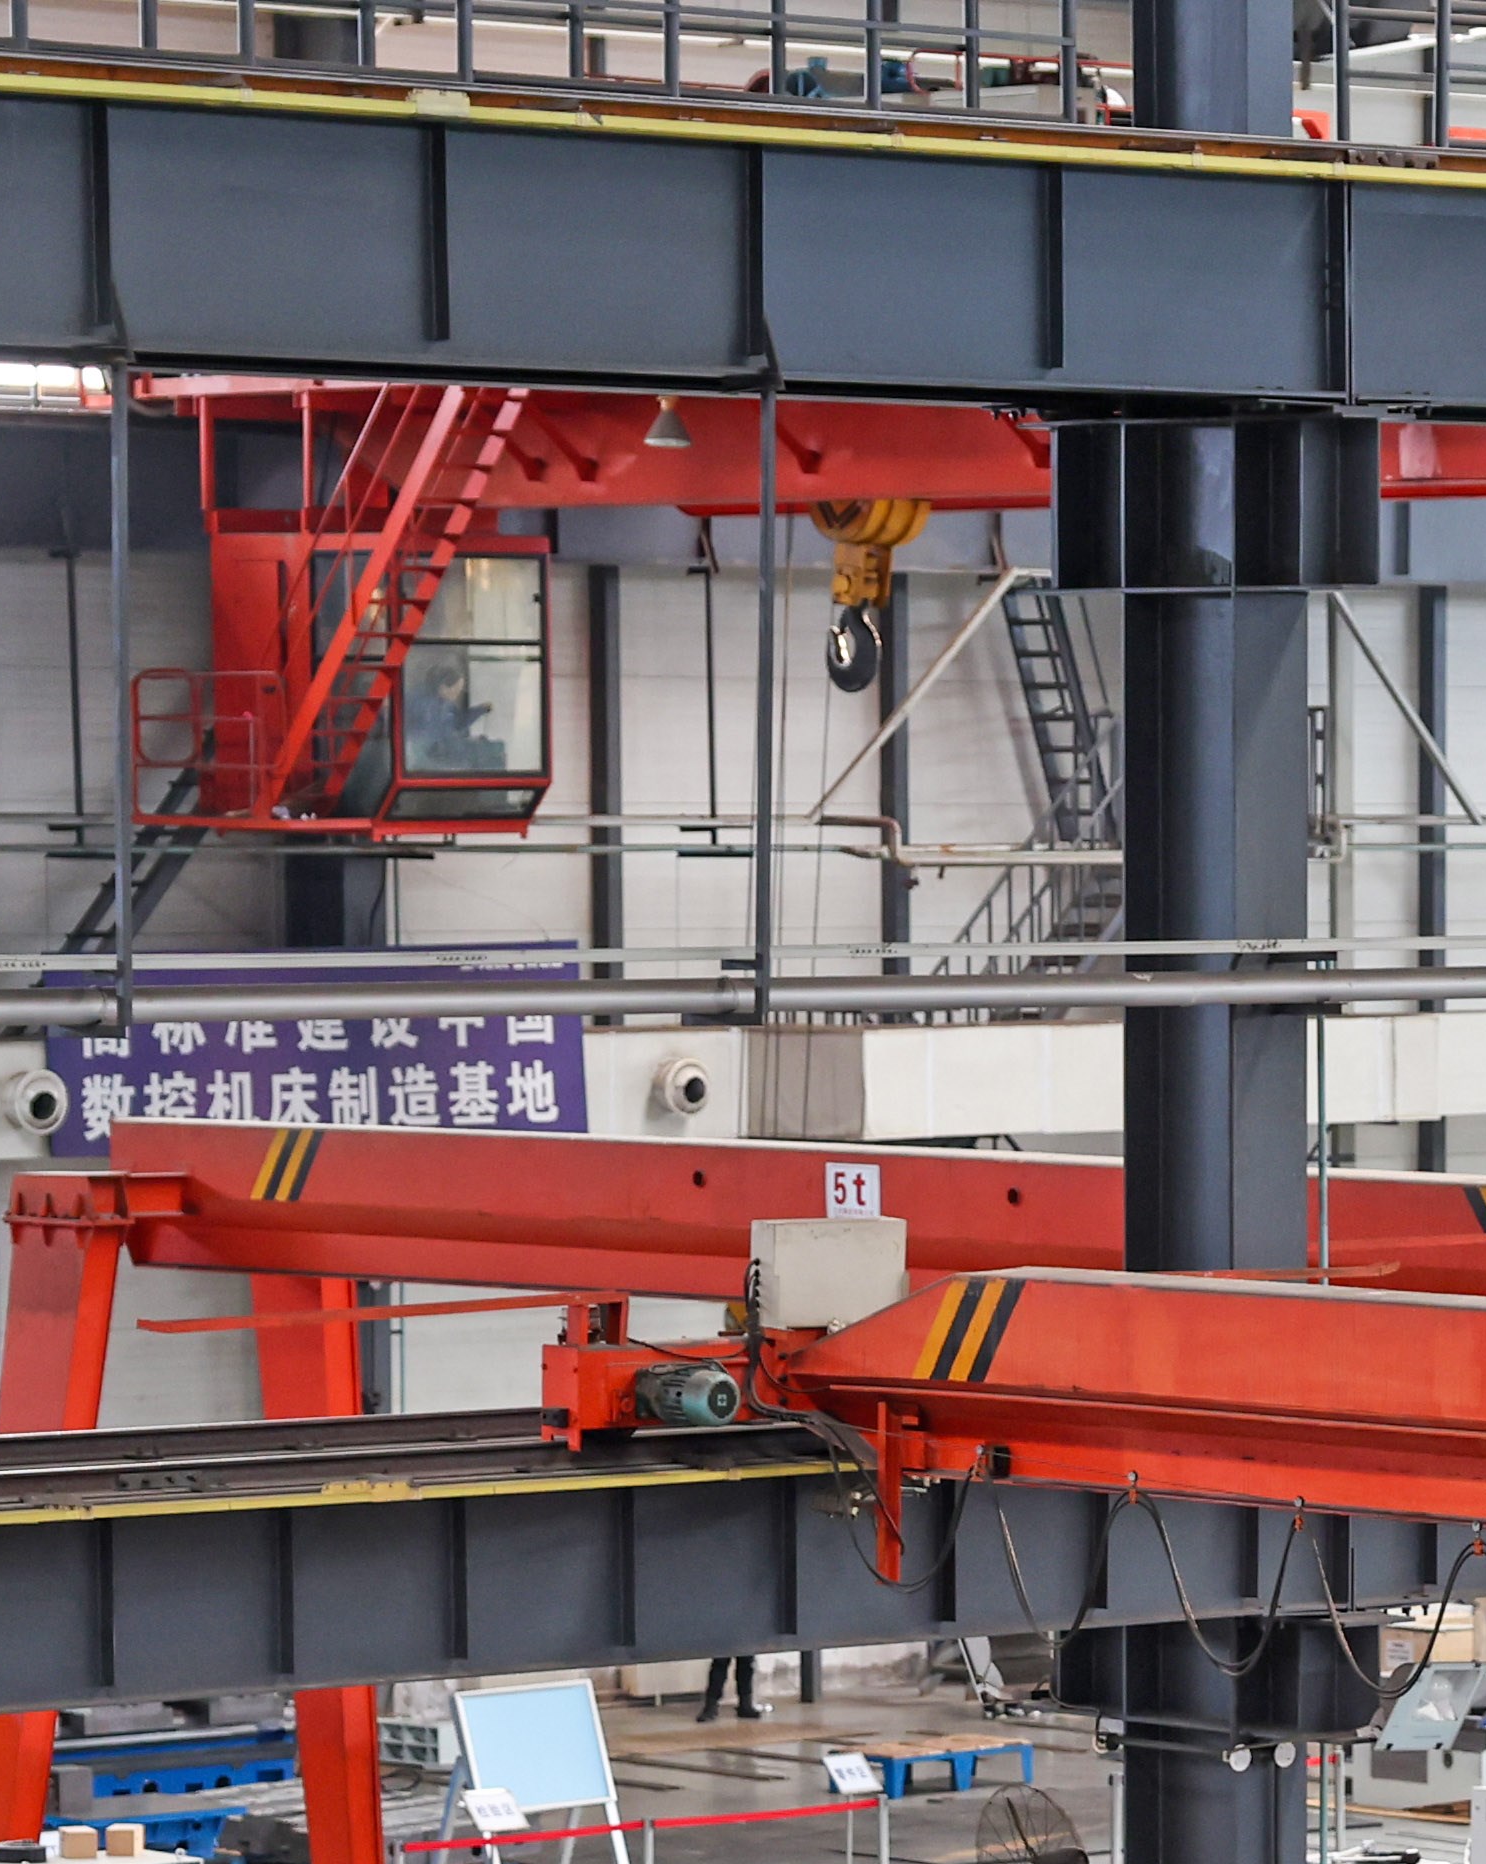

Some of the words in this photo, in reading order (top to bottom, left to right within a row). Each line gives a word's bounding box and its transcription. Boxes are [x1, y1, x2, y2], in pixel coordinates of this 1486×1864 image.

[81, 1059, 560, 1141] 数控机床制造基地
[832, 1171, 867, 1206] 5t
